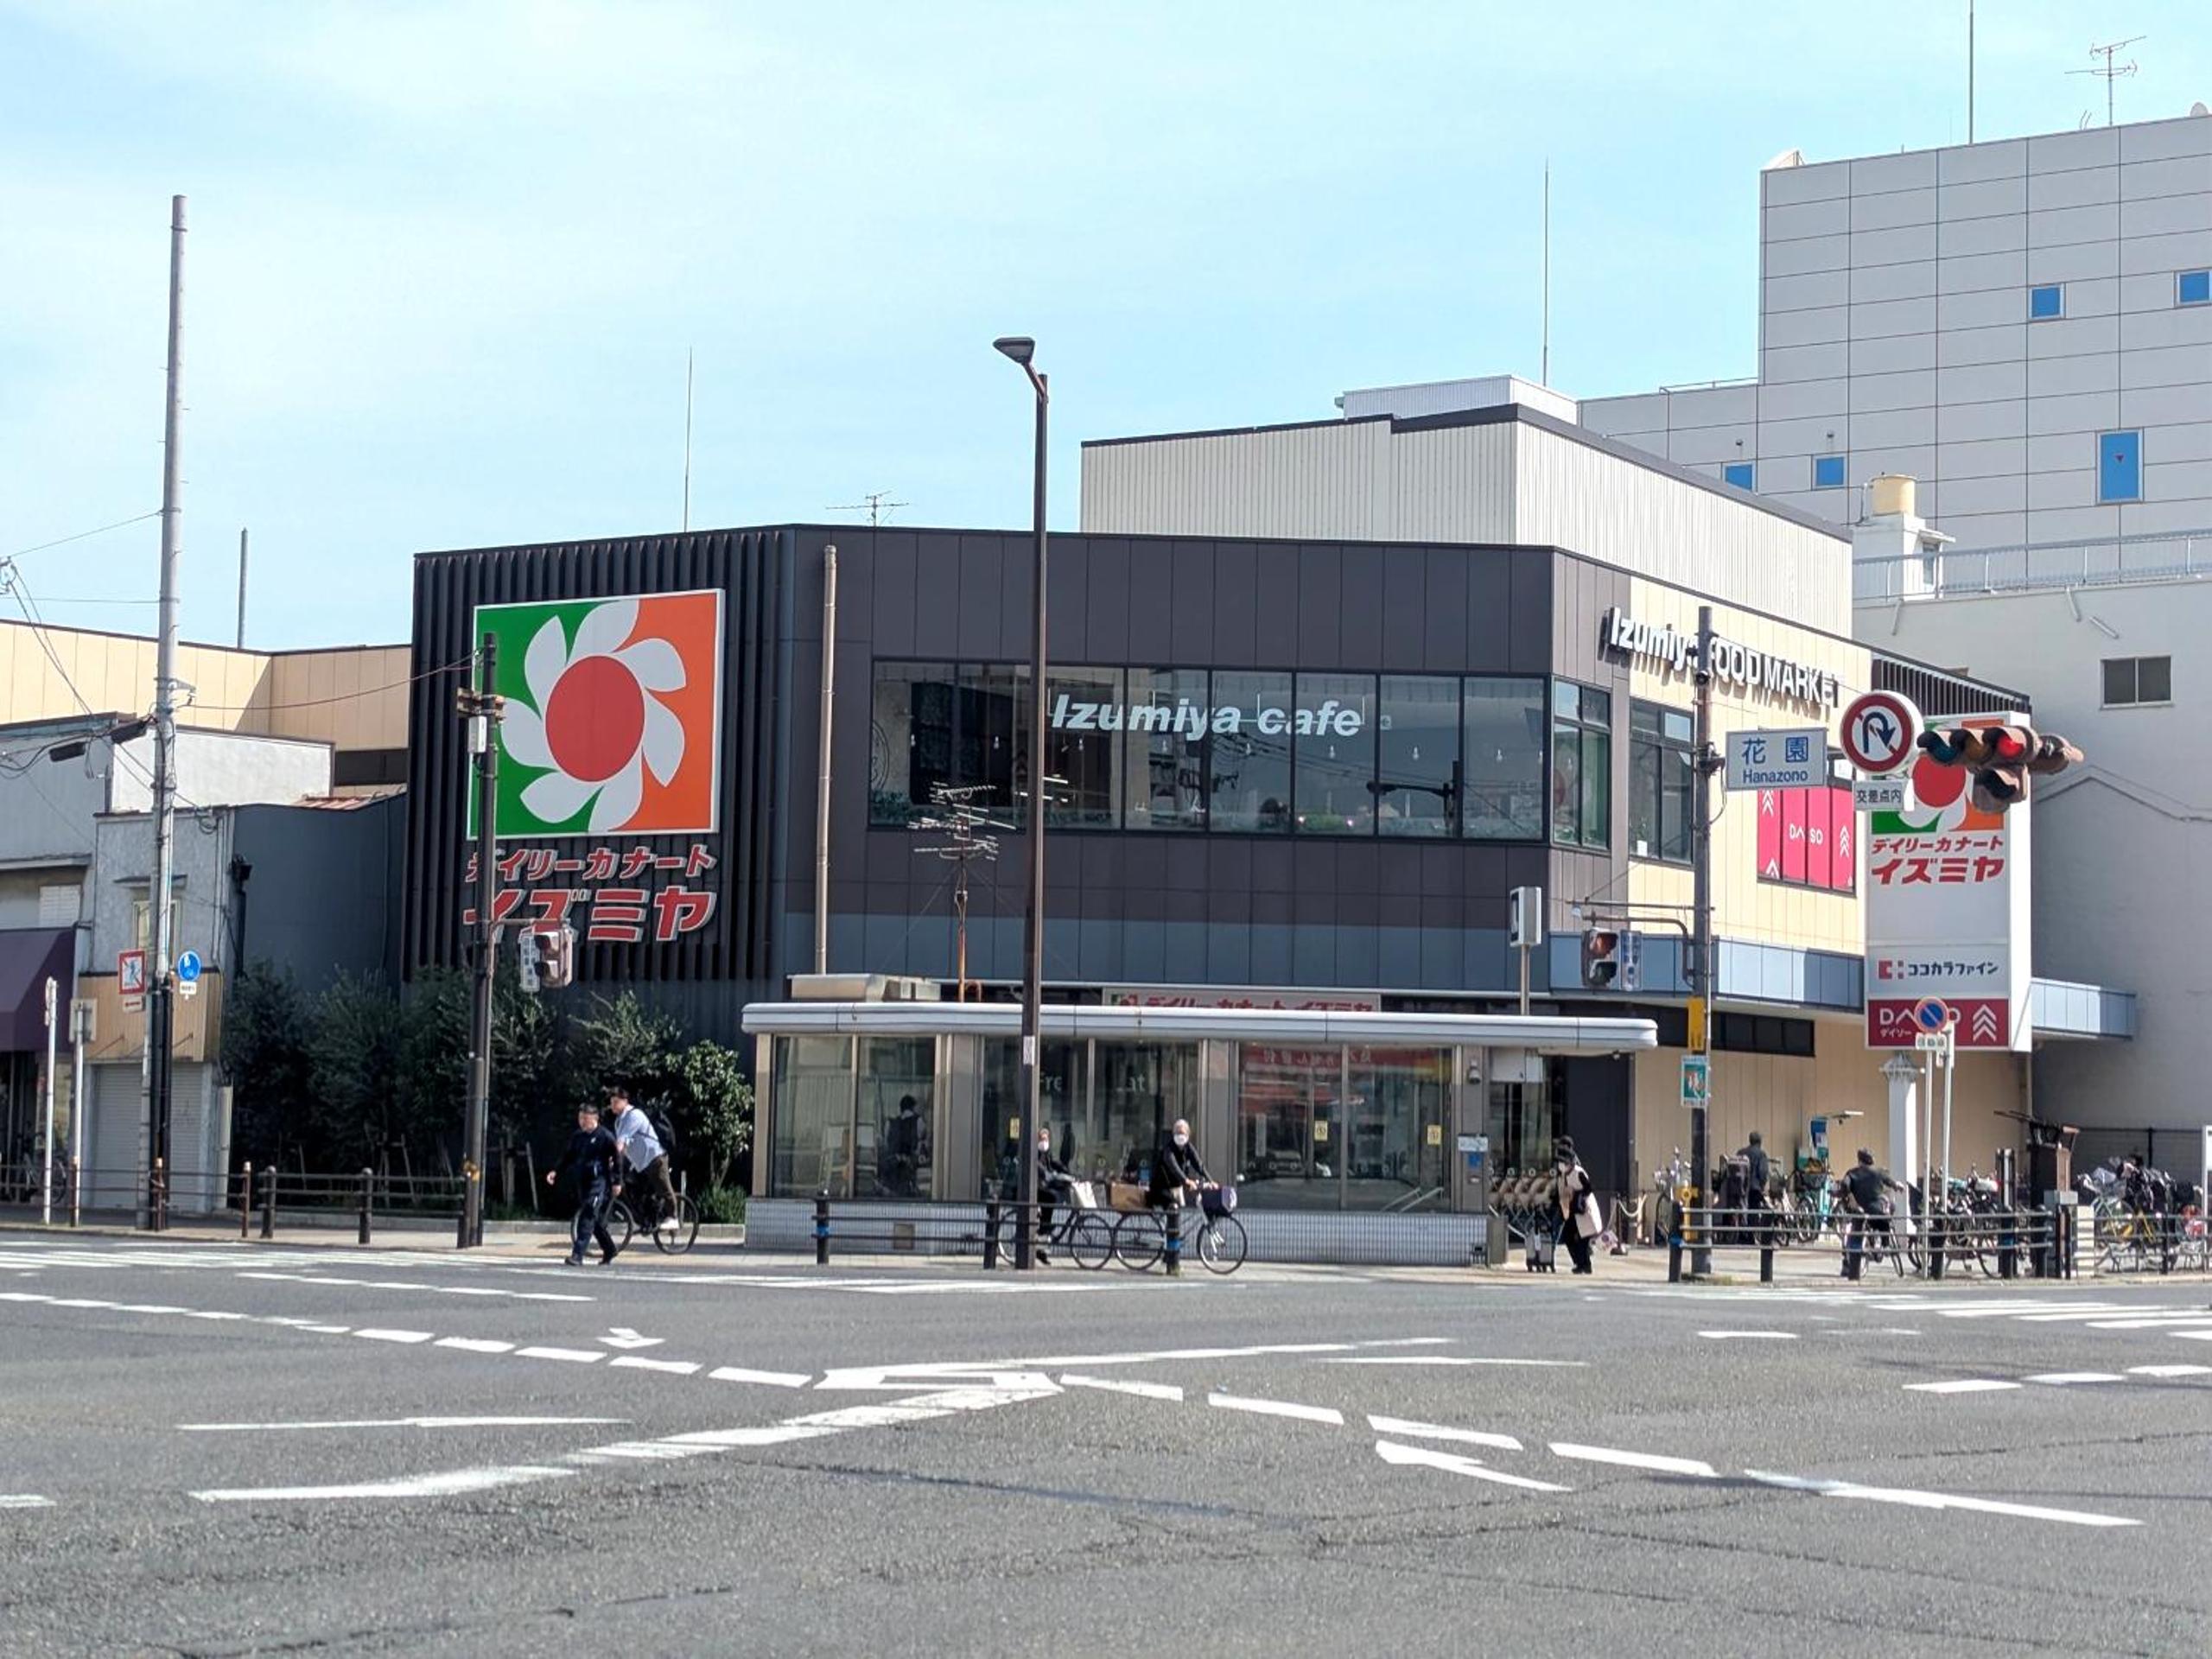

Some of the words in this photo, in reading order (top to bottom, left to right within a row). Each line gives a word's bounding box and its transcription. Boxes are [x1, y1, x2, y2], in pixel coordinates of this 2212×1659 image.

[1052, 694, 1241, 741] Izumiya
[1258, 701, 1361, 736] cafe
[1743, 770, 1808, 784] Hanazono
[1857, 789, 1902, 804] 交差点内
[1872, 836, 2004, 855] デイリーカナート
[1872, 856, 2005, 885] イズミヤ
[1908, 961, 1999, 976] ココカラファイン
[1879, 1008, 1961, 1026] DAO
